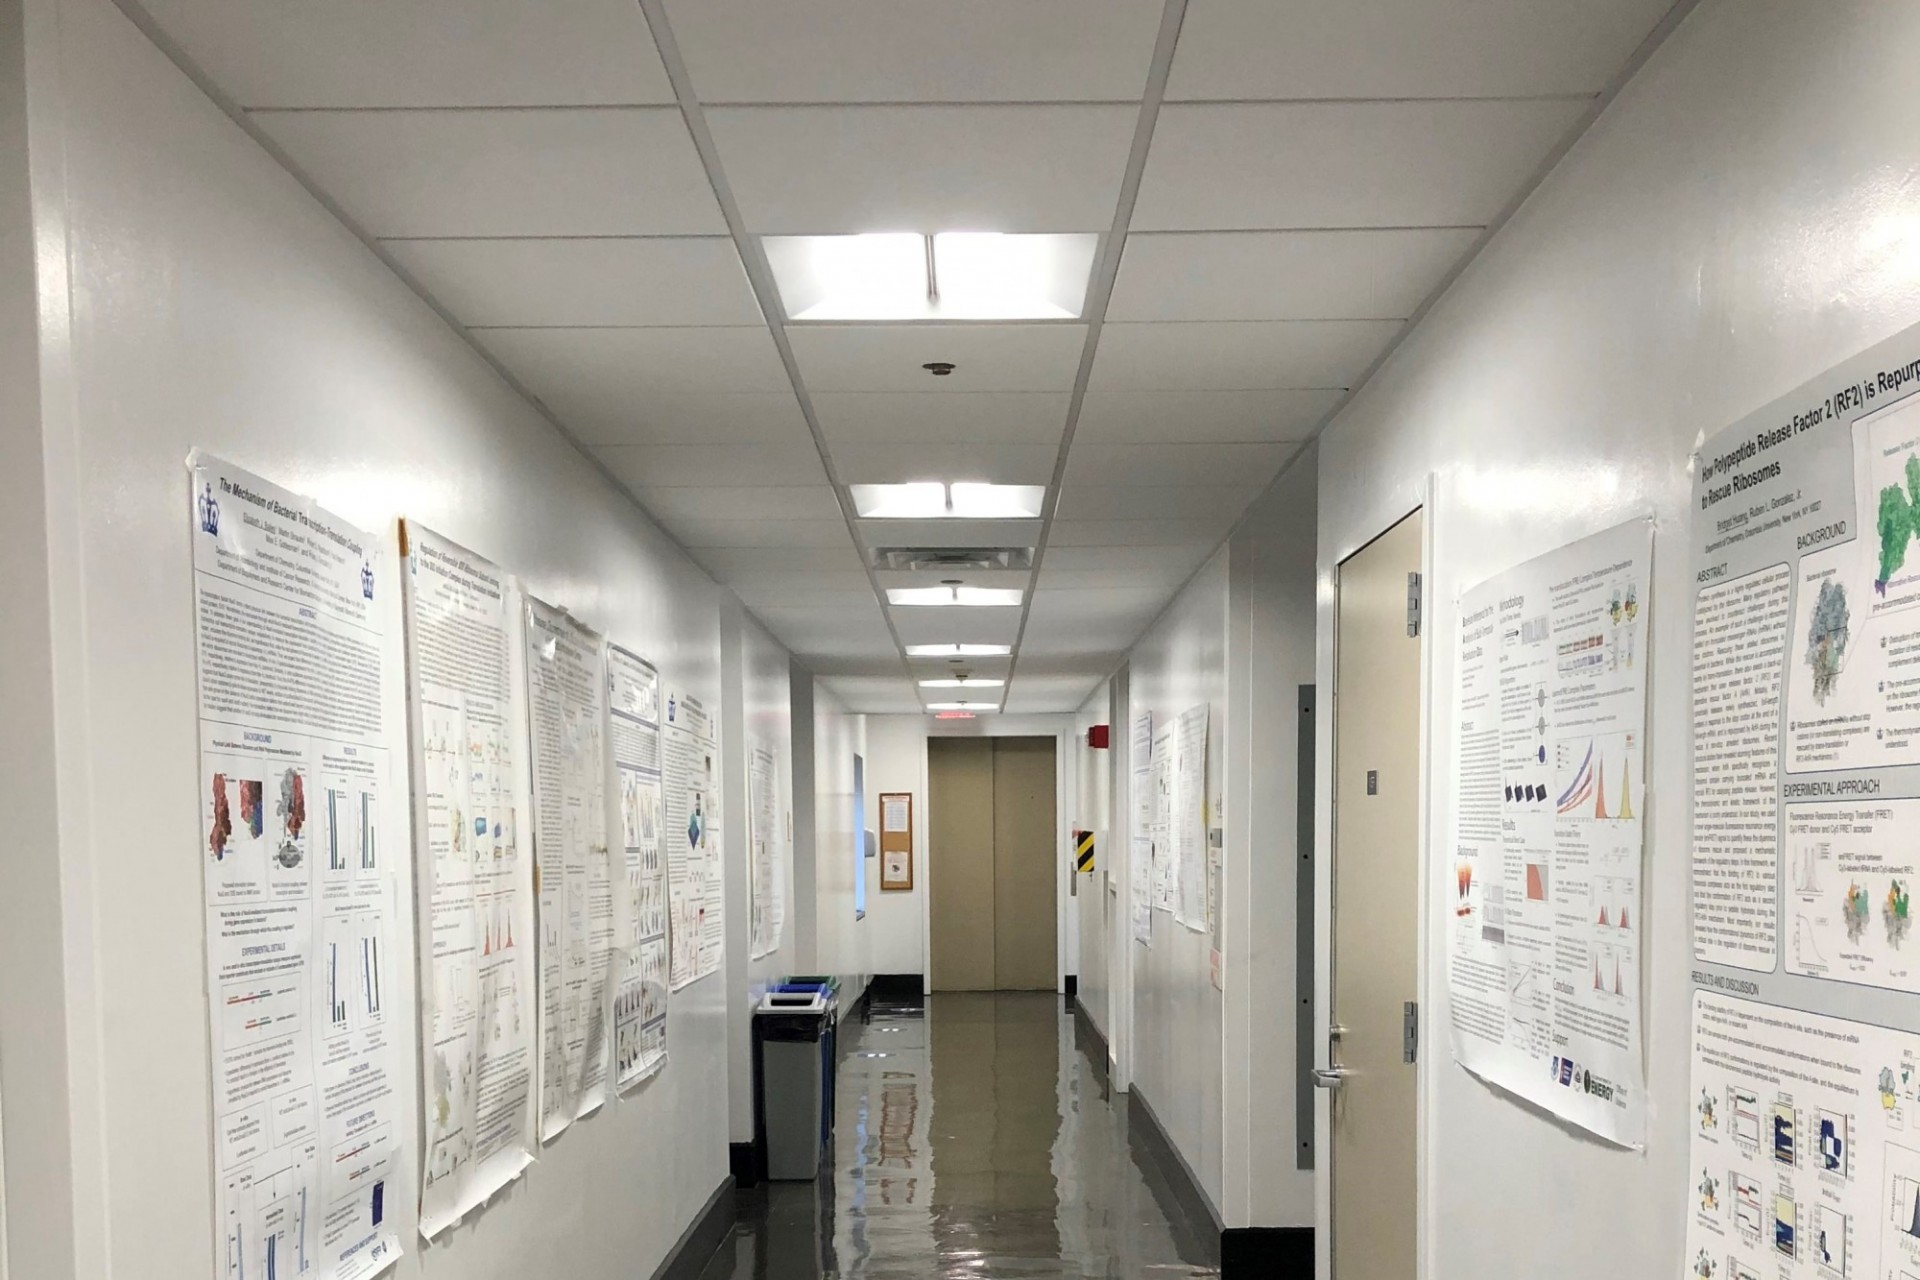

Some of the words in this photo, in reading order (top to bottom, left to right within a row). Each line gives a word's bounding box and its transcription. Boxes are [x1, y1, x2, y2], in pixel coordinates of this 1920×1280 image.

[1702, 463, 1713, 483] How
[1714, 440, 1756, 474] Polypeptide
[1757, 423, 1792, 452] Release
[1793, 408, 1823, 435] Factor
[1826, 401, 1832, 419] 2
[1834, 384, 1863, 419] (RF2)
[1864, 381, 1875, 400] is
[220, 477, 231, 494] The
[232, 483, 266, 509] Mechanism
[266, 497, 273, 510] of
[273, 502, 298, 520] Bacterial
[1701, 497, 1708, 510] to
[1708, 483, 1731, 506] Rescue
[1733, 460, 1781, 494] Ribosomes
[1797, 521, 1846, 550] BACKGROUND
[1697, 563, 1728, 582] ABSTRACT
[1784, 784, 1835, 798] EXPERIMENTAL
[1836, 779, 1880, 795] APPROACH
[1691, 970, 1714, 988] RESULTS
[1714, 977, 1724, 990] AND
[1726, 978, 1759, 996] DISCUSSION
[1591, 1084, 1614, 1102] ENERGY
